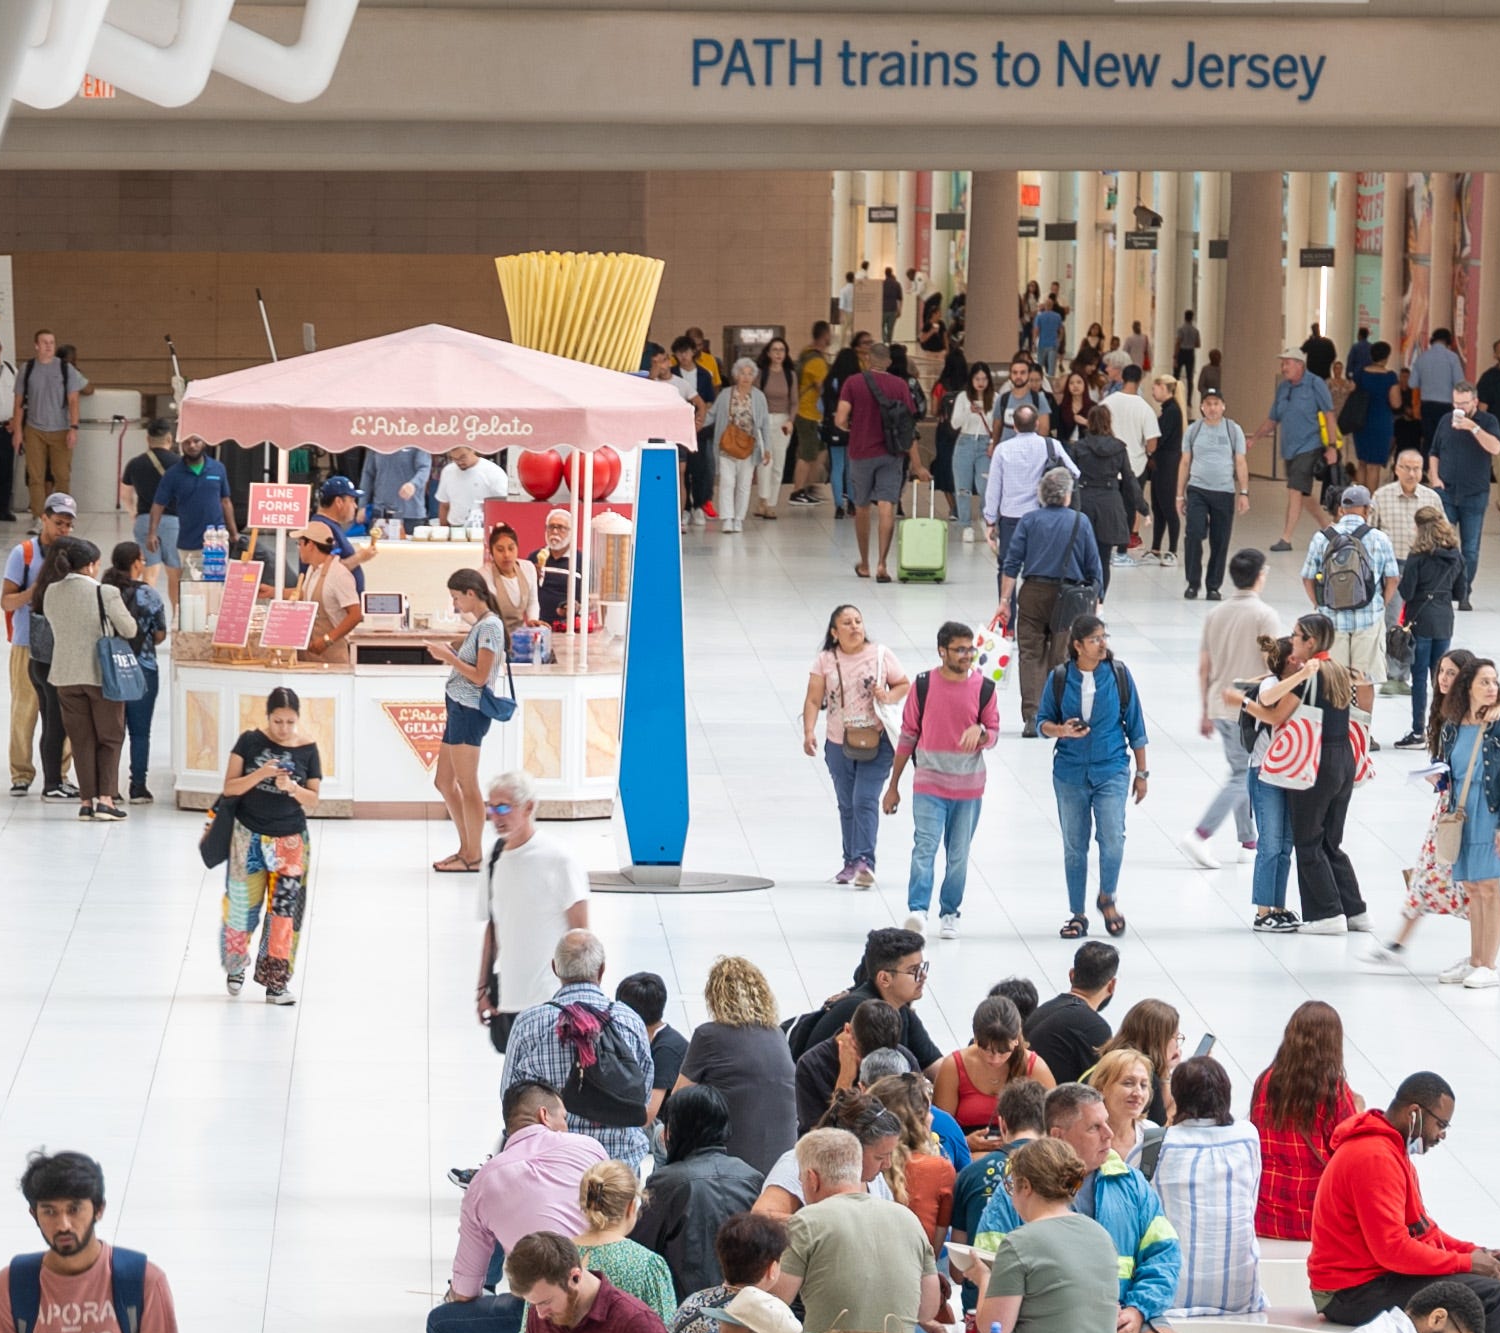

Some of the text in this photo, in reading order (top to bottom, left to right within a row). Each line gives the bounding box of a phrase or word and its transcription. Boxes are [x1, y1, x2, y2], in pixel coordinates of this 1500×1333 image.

[691, 38, 1326, 103] PATH trains to New Jersey
[423, 415, 460, 436] del
[463, 415, 534, 442] Gelato
[266, 487, 294, 498] LINE
[258, 500, 301, 512] FORMS
[262, 513, 295, 525] HERE
